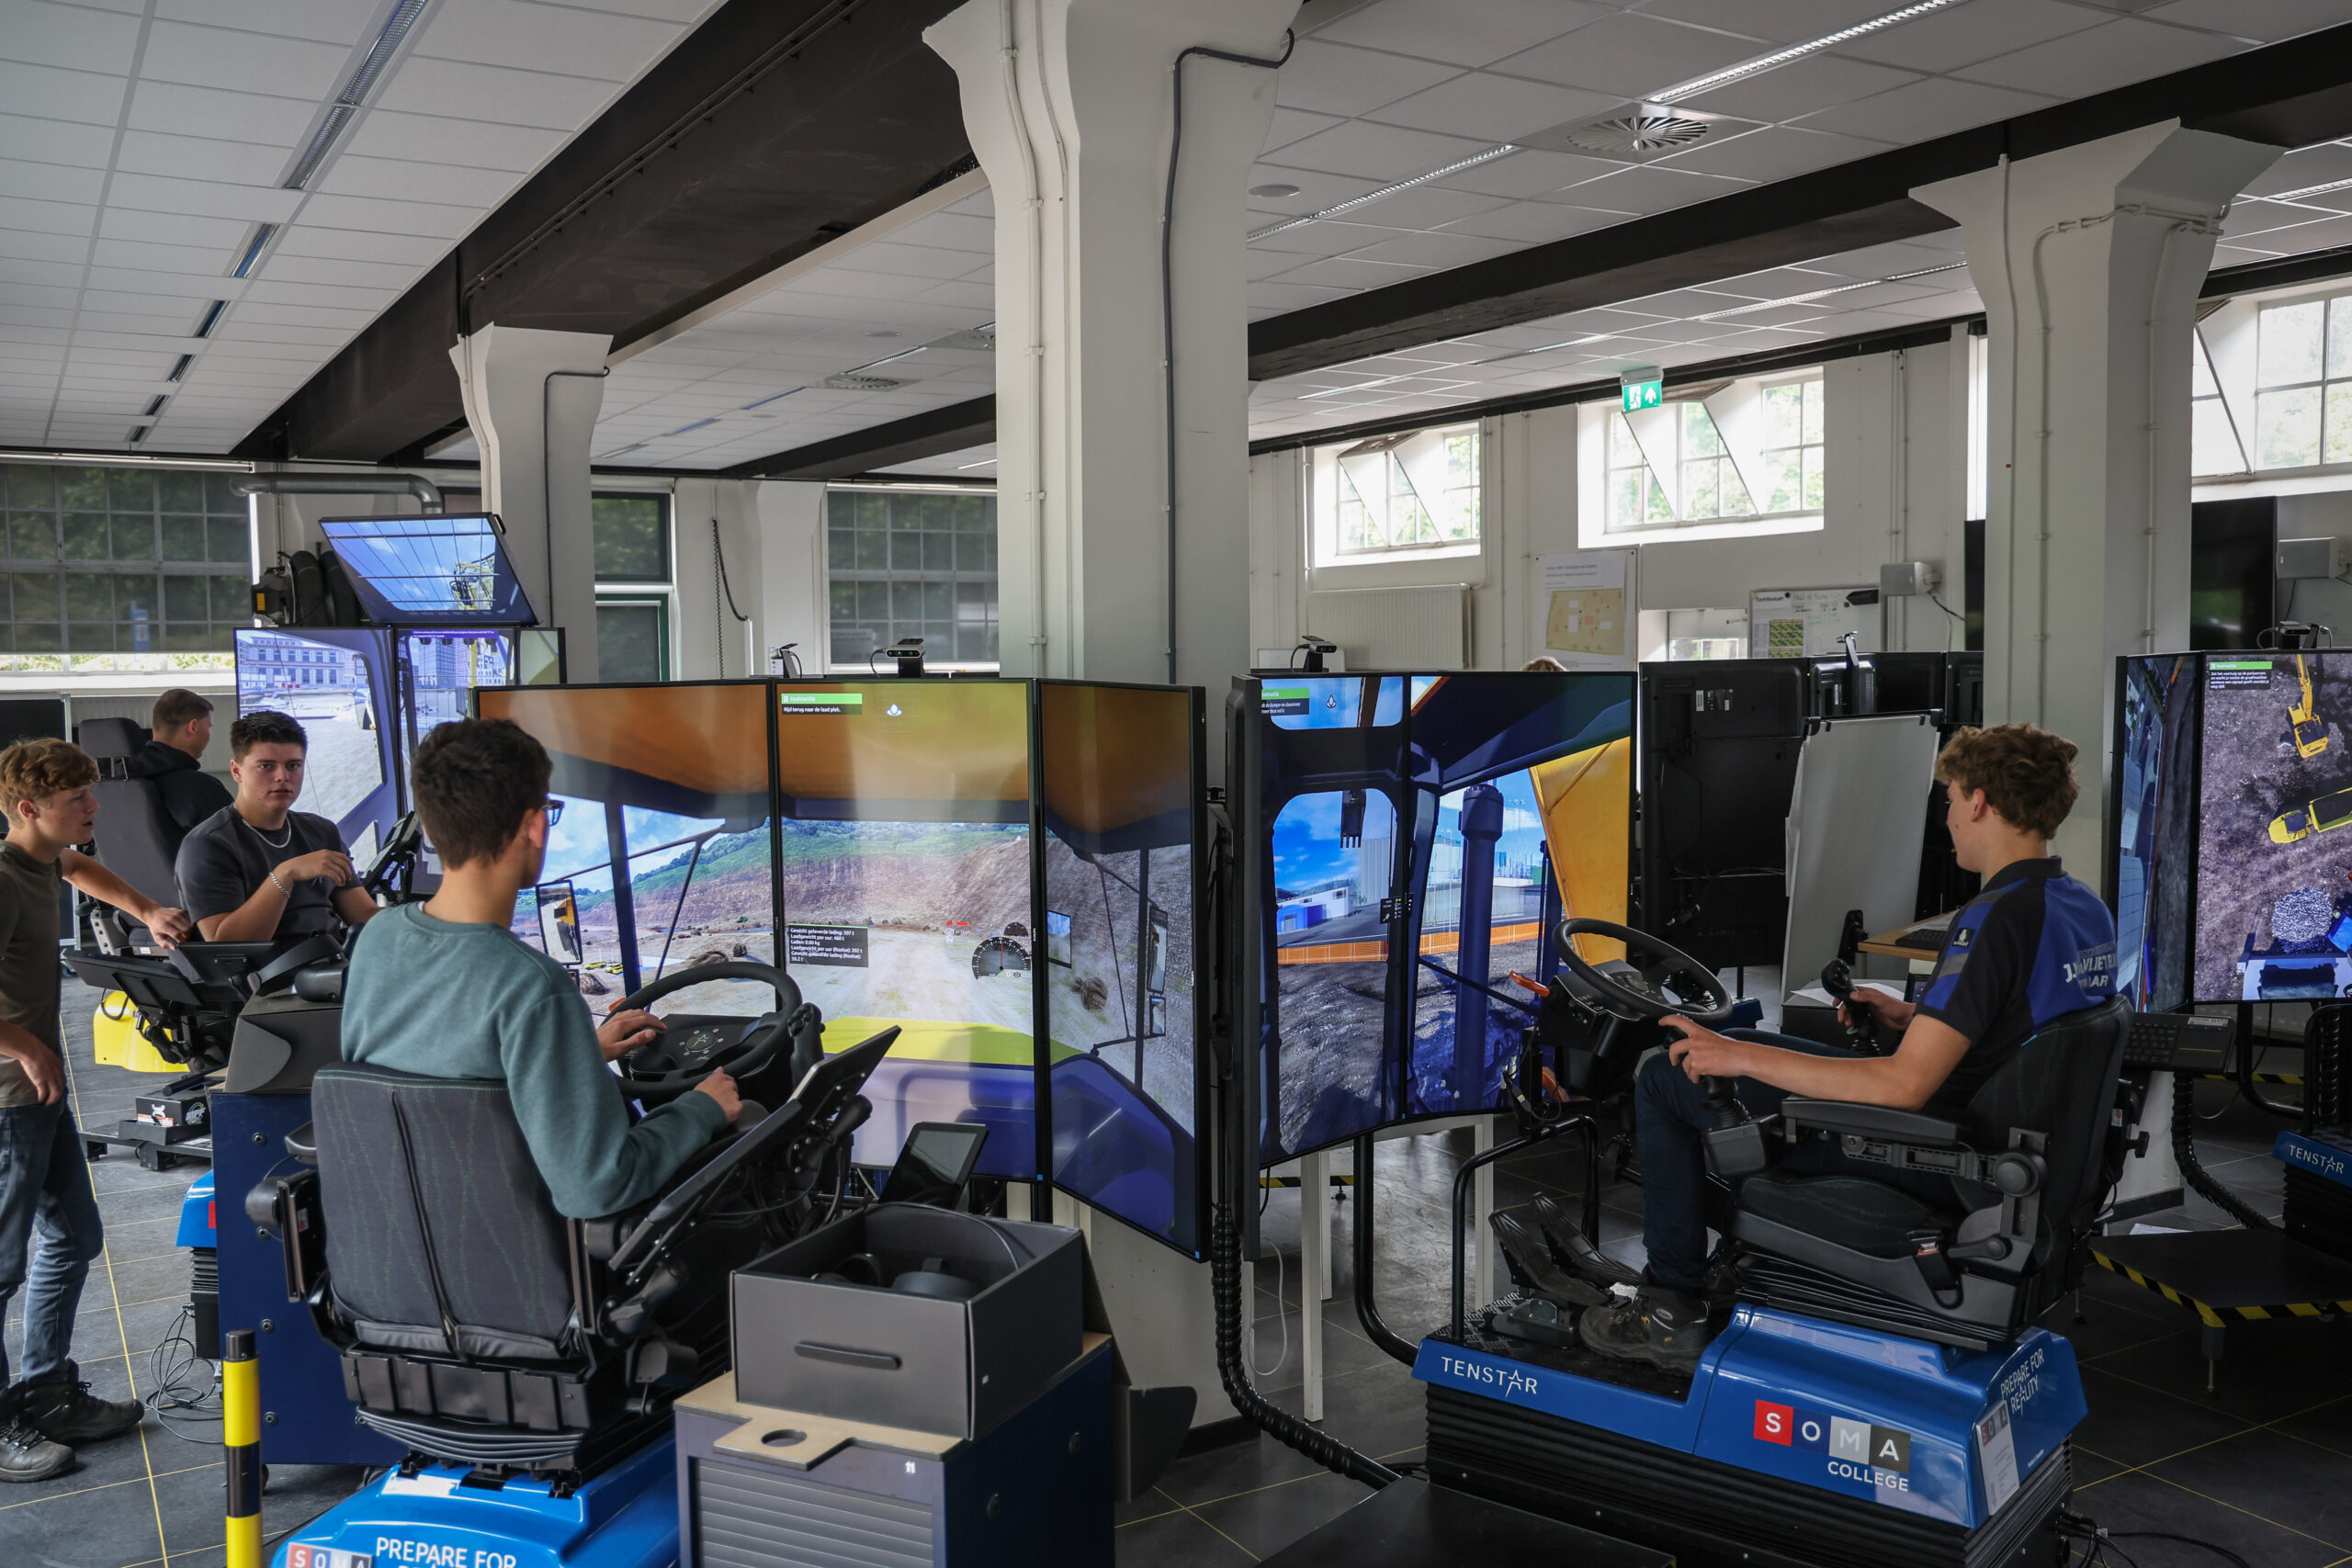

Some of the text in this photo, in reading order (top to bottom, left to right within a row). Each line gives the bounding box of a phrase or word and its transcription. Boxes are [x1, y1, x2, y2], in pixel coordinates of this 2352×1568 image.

[2290, 1145, 2345, 1175] TENSTAR
[1441, 1356, 1538, 1397] TENSTAR
[2000, 1348, 2045, 1399] PREPARE FOR
[2010, 1374, 2040, 1416] REALITY
[1765, 1412, 1900, 1461] SOMA
[1981, 1406, 2008, 1443] SOA
[905, 1461, 915, 1474] 11
[1827, 1461, 1909, 1492] COLLEGE
[376, 1537, 517, 1568] PREPARE FOR
